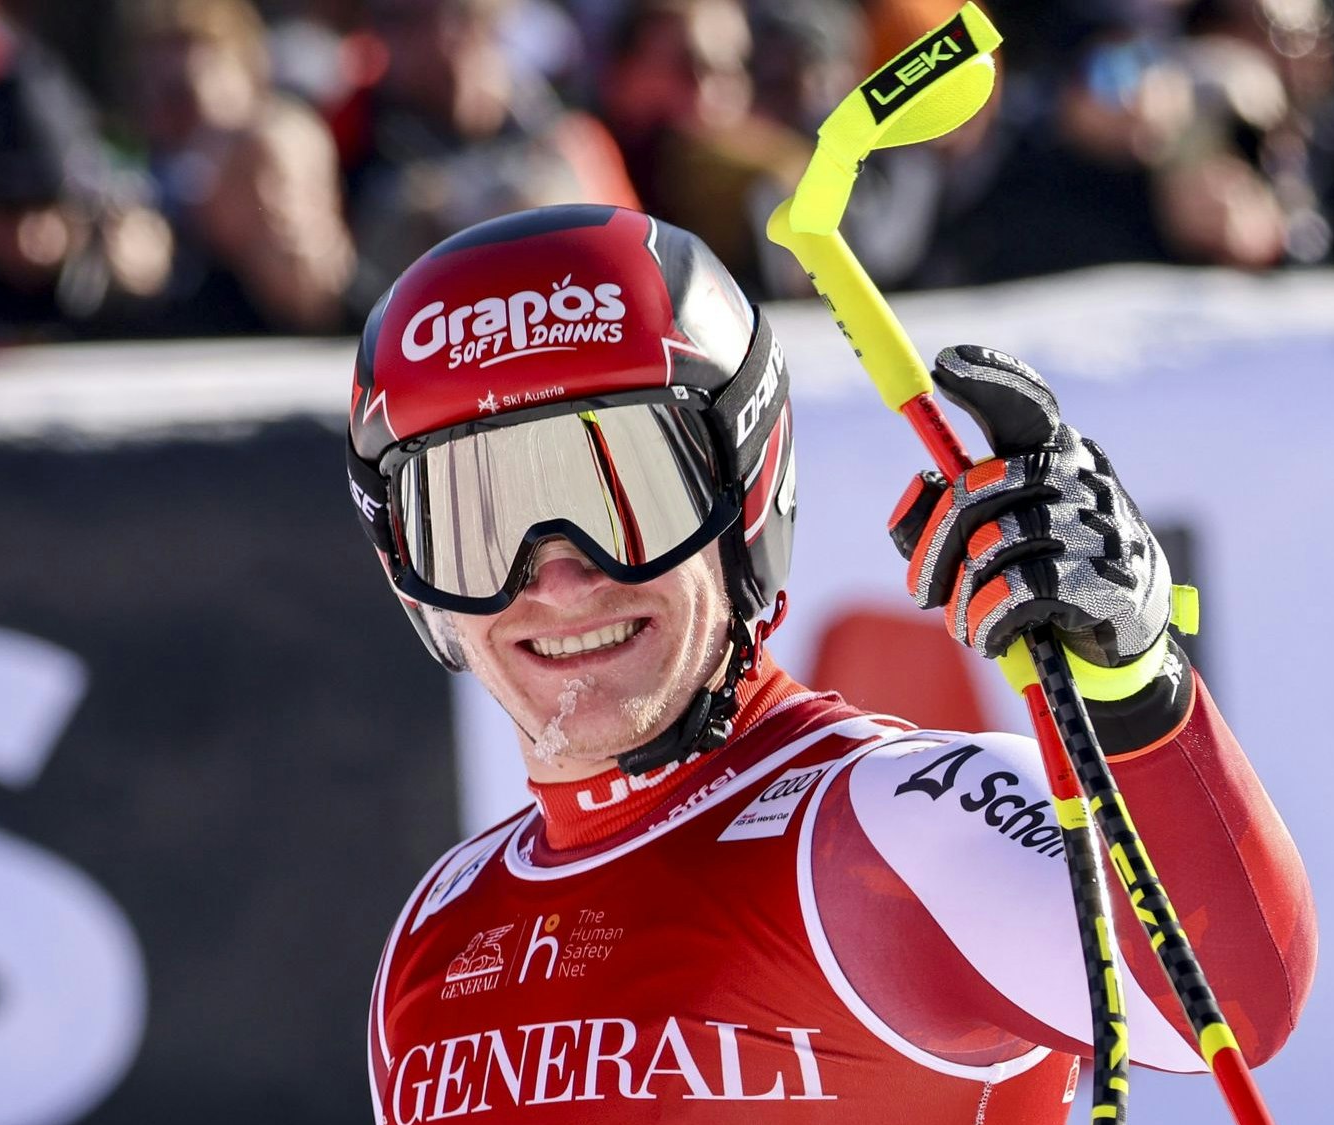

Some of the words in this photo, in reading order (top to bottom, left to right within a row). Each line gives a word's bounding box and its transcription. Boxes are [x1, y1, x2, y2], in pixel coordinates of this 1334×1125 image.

[870, 35, 962, 106] LEKI
[448, 331, 507, 369] SOFT
[529, 322, 623, 346] DRINKS
[502, 392, 521, 406] Ski
[523, 384, 566, 402] Austria
[756, 814, 776, 823] World
[776, 812, 790, 821] Cup
[578, 909, 605, 924] The
[569, 927, 624, 942] Human
[562, 943, 613, 961] Safety
[557, 961, 587, 977] Net
[441, 973, 500, 1000] GENERALI
